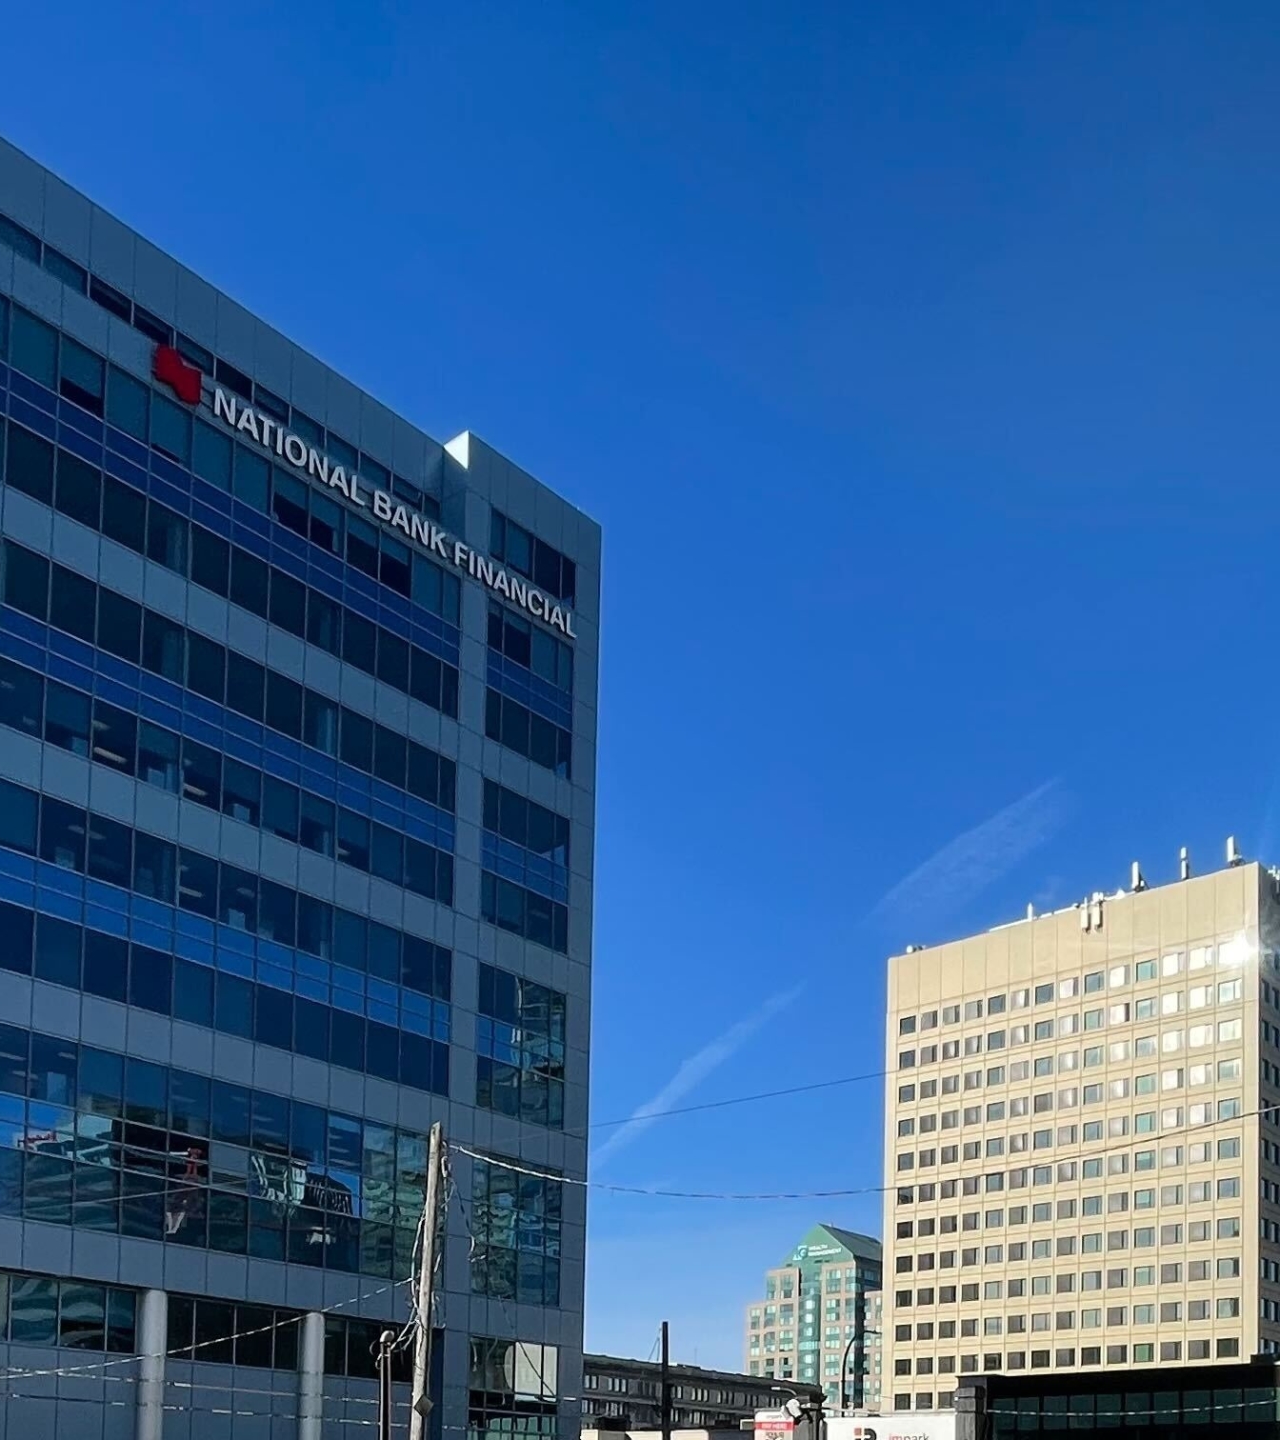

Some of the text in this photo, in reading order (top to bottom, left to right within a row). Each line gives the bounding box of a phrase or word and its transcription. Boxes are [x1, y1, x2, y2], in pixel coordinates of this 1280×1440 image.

[214, 388, 577, 638] NATIONAL BANK FINANCIAL
